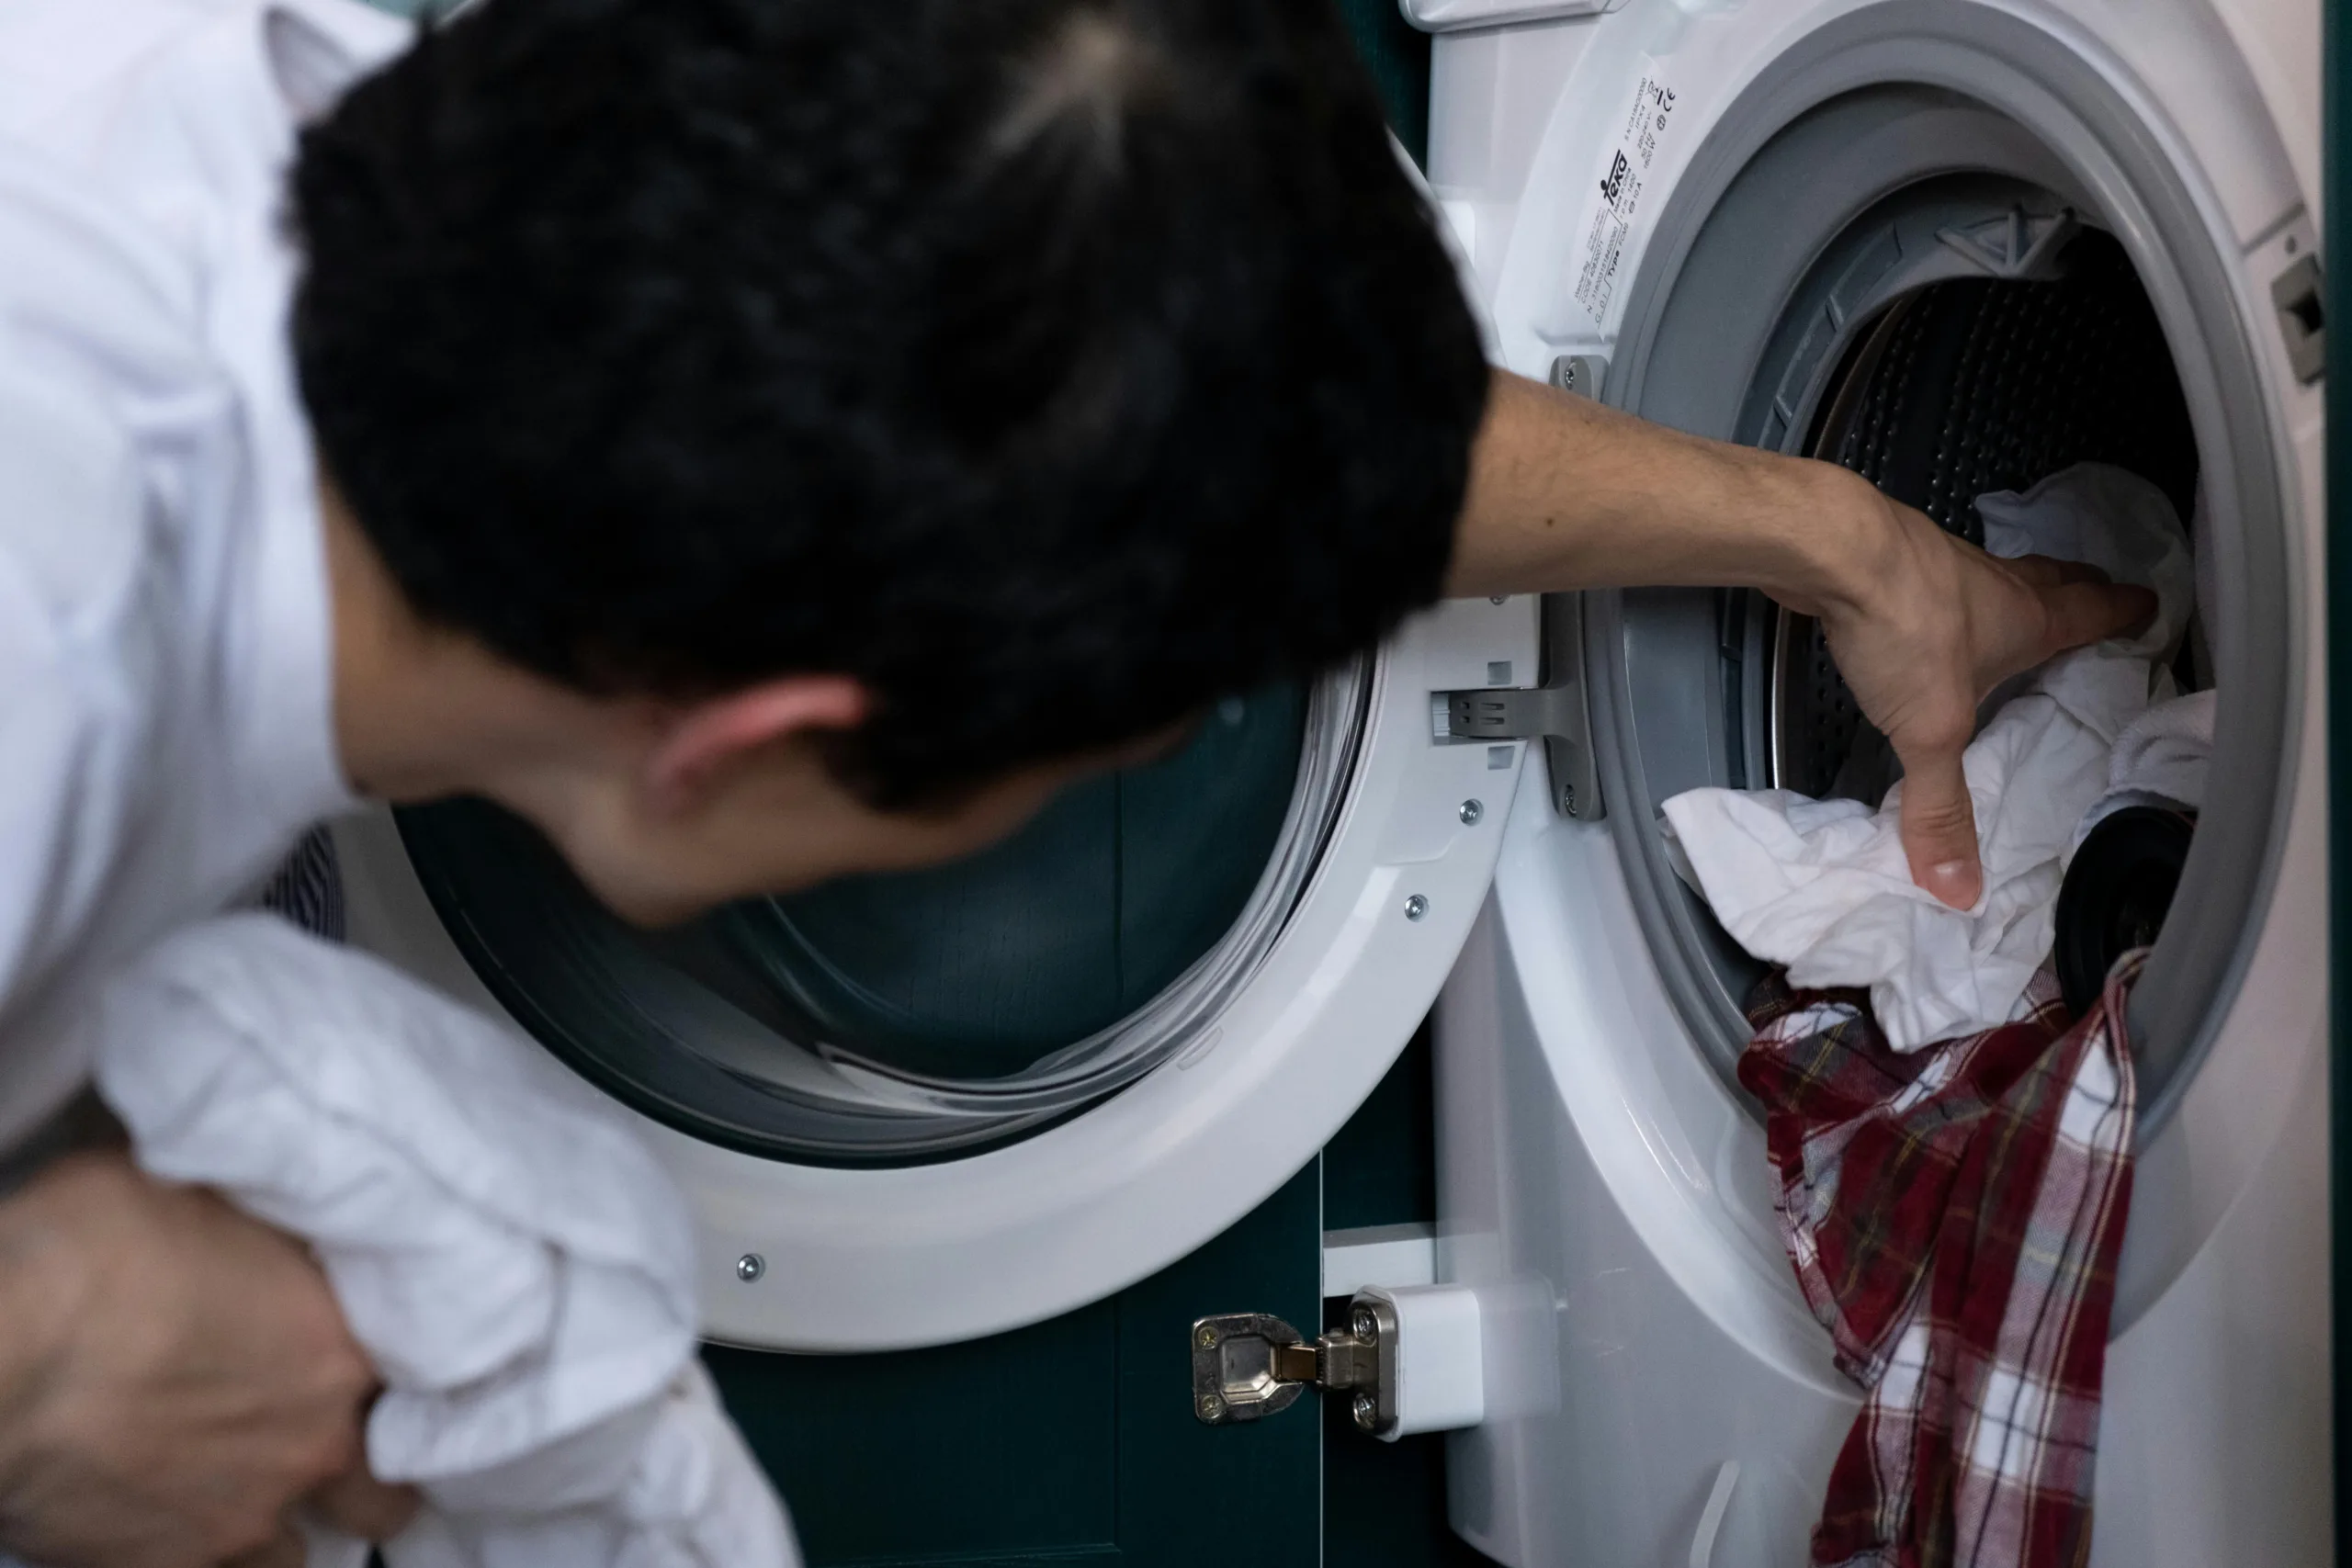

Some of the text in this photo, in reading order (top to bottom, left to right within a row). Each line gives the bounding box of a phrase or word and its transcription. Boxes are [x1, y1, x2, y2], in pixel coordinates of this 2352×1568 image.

[1613, 196, 1622, 213] Made
[1623, 167, 1632, 186] China
[1628, 174, 1636, 192] 1400
[1581, 278, 1591, 304] CODE
